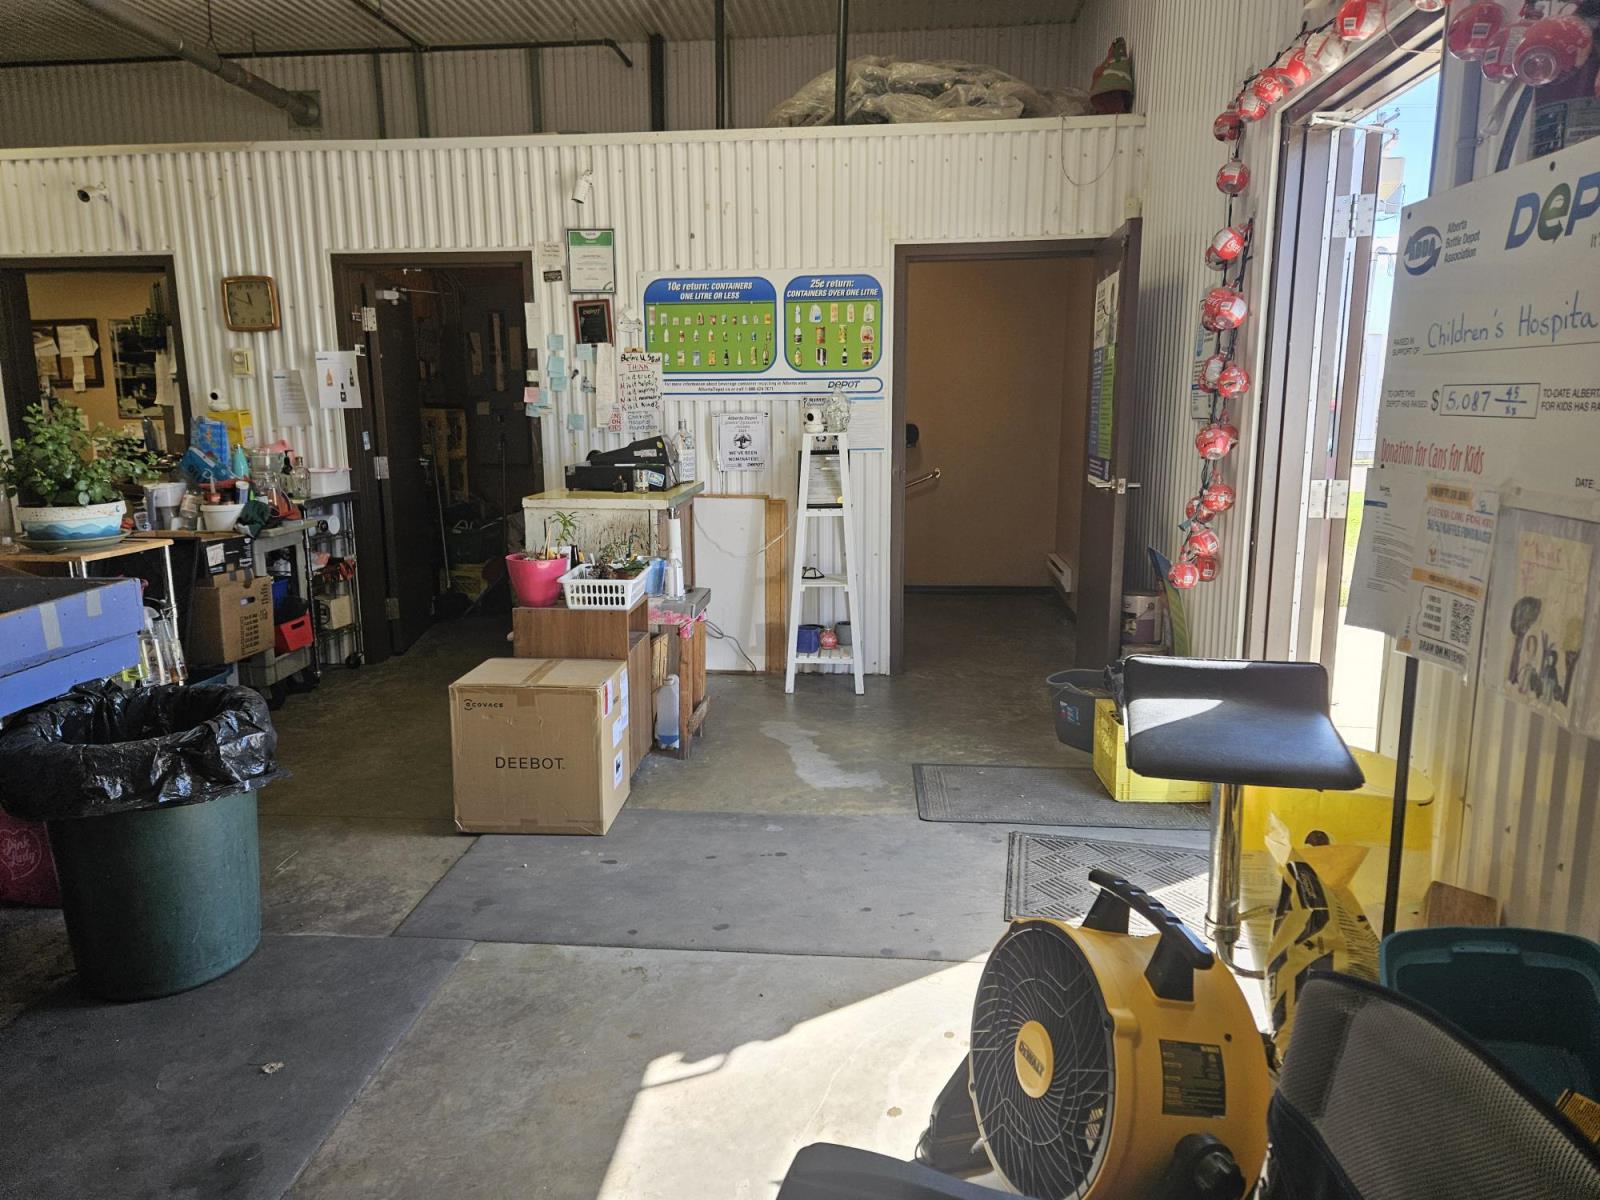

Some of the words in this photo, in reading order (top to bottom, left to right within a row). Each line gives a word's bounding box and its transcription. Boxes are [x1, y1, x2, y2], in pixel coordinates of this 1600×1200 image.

[1447, 220, 1468, 233] Alberta
[1445, 236, 1462, 248] Bottle
[1462, 230, 1480, 244] Depot
[682, 282, 709, 291] return:
[711, 281, 753, 291] CONTAINERS
[826, 280, 854, 288] return:
[680, 292, 694, 300] ONE
[694, 292, 713, 300] LITRE
[787, 289, 827, 298] CONTAINERS
[827, 289, 845, 297] OVER
[860, 288, 879, 296] LITRE
[1428, 308, 1504, 348] Children's
[1543, 388, 1571, 398] TO-DATE
[1430, 389, 1440, 411] $
[1541, 402, 1556, 411] FOR
[1556, 402, 1573, 411] KIDS
[1574, 402, 1590, 411] HAS
[1381, 438, 1414, 465] Donation
[1414, 440, 1427, 467] for
[1428, 442, 1448, 470] Cans
[1448, 443, 1463, 472] for
[1463, 445, 1485, 475] Kids
